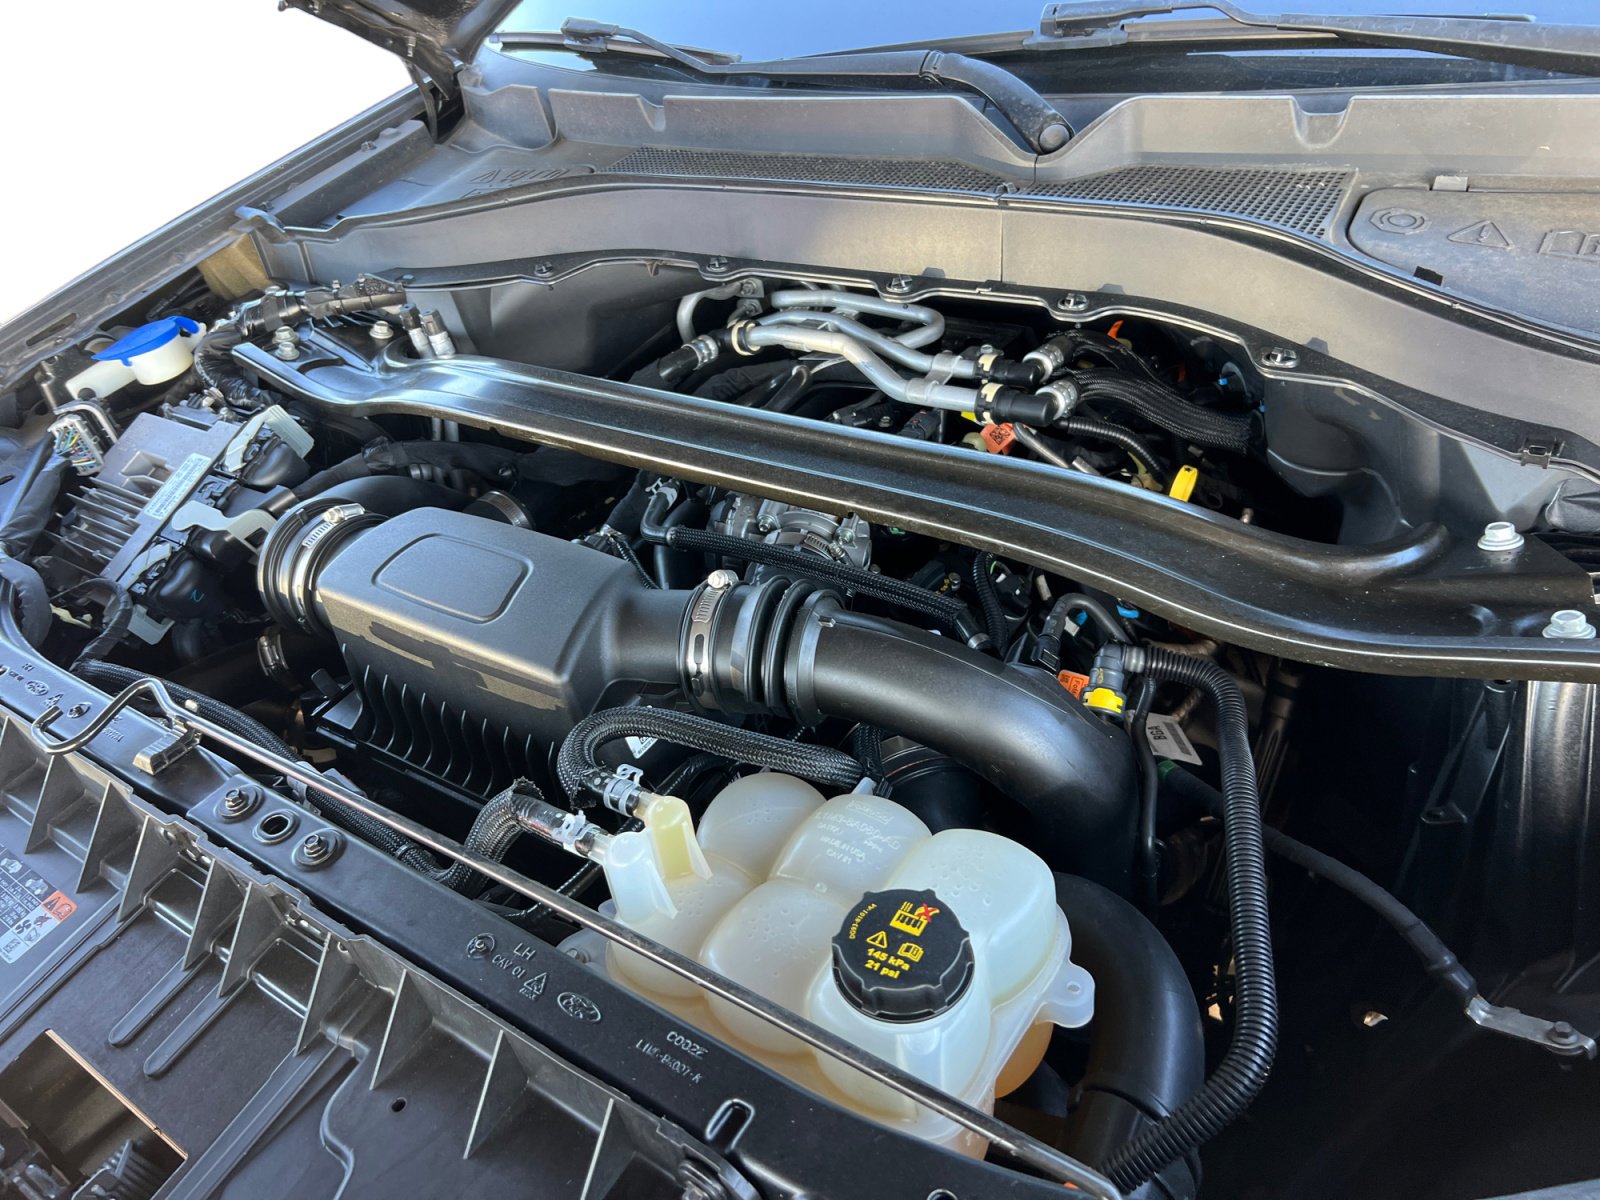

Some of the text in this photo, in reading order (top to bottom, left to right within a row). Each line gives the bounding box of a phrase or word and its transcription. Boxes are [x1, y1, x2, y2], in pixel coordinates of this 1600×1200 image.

[512, 942, 536, 961] LH
[867, 947, 911, 972] 145 kPa
[491, 954, 513, 970] CAV
[864, 959, 901, 980] 21 psi
